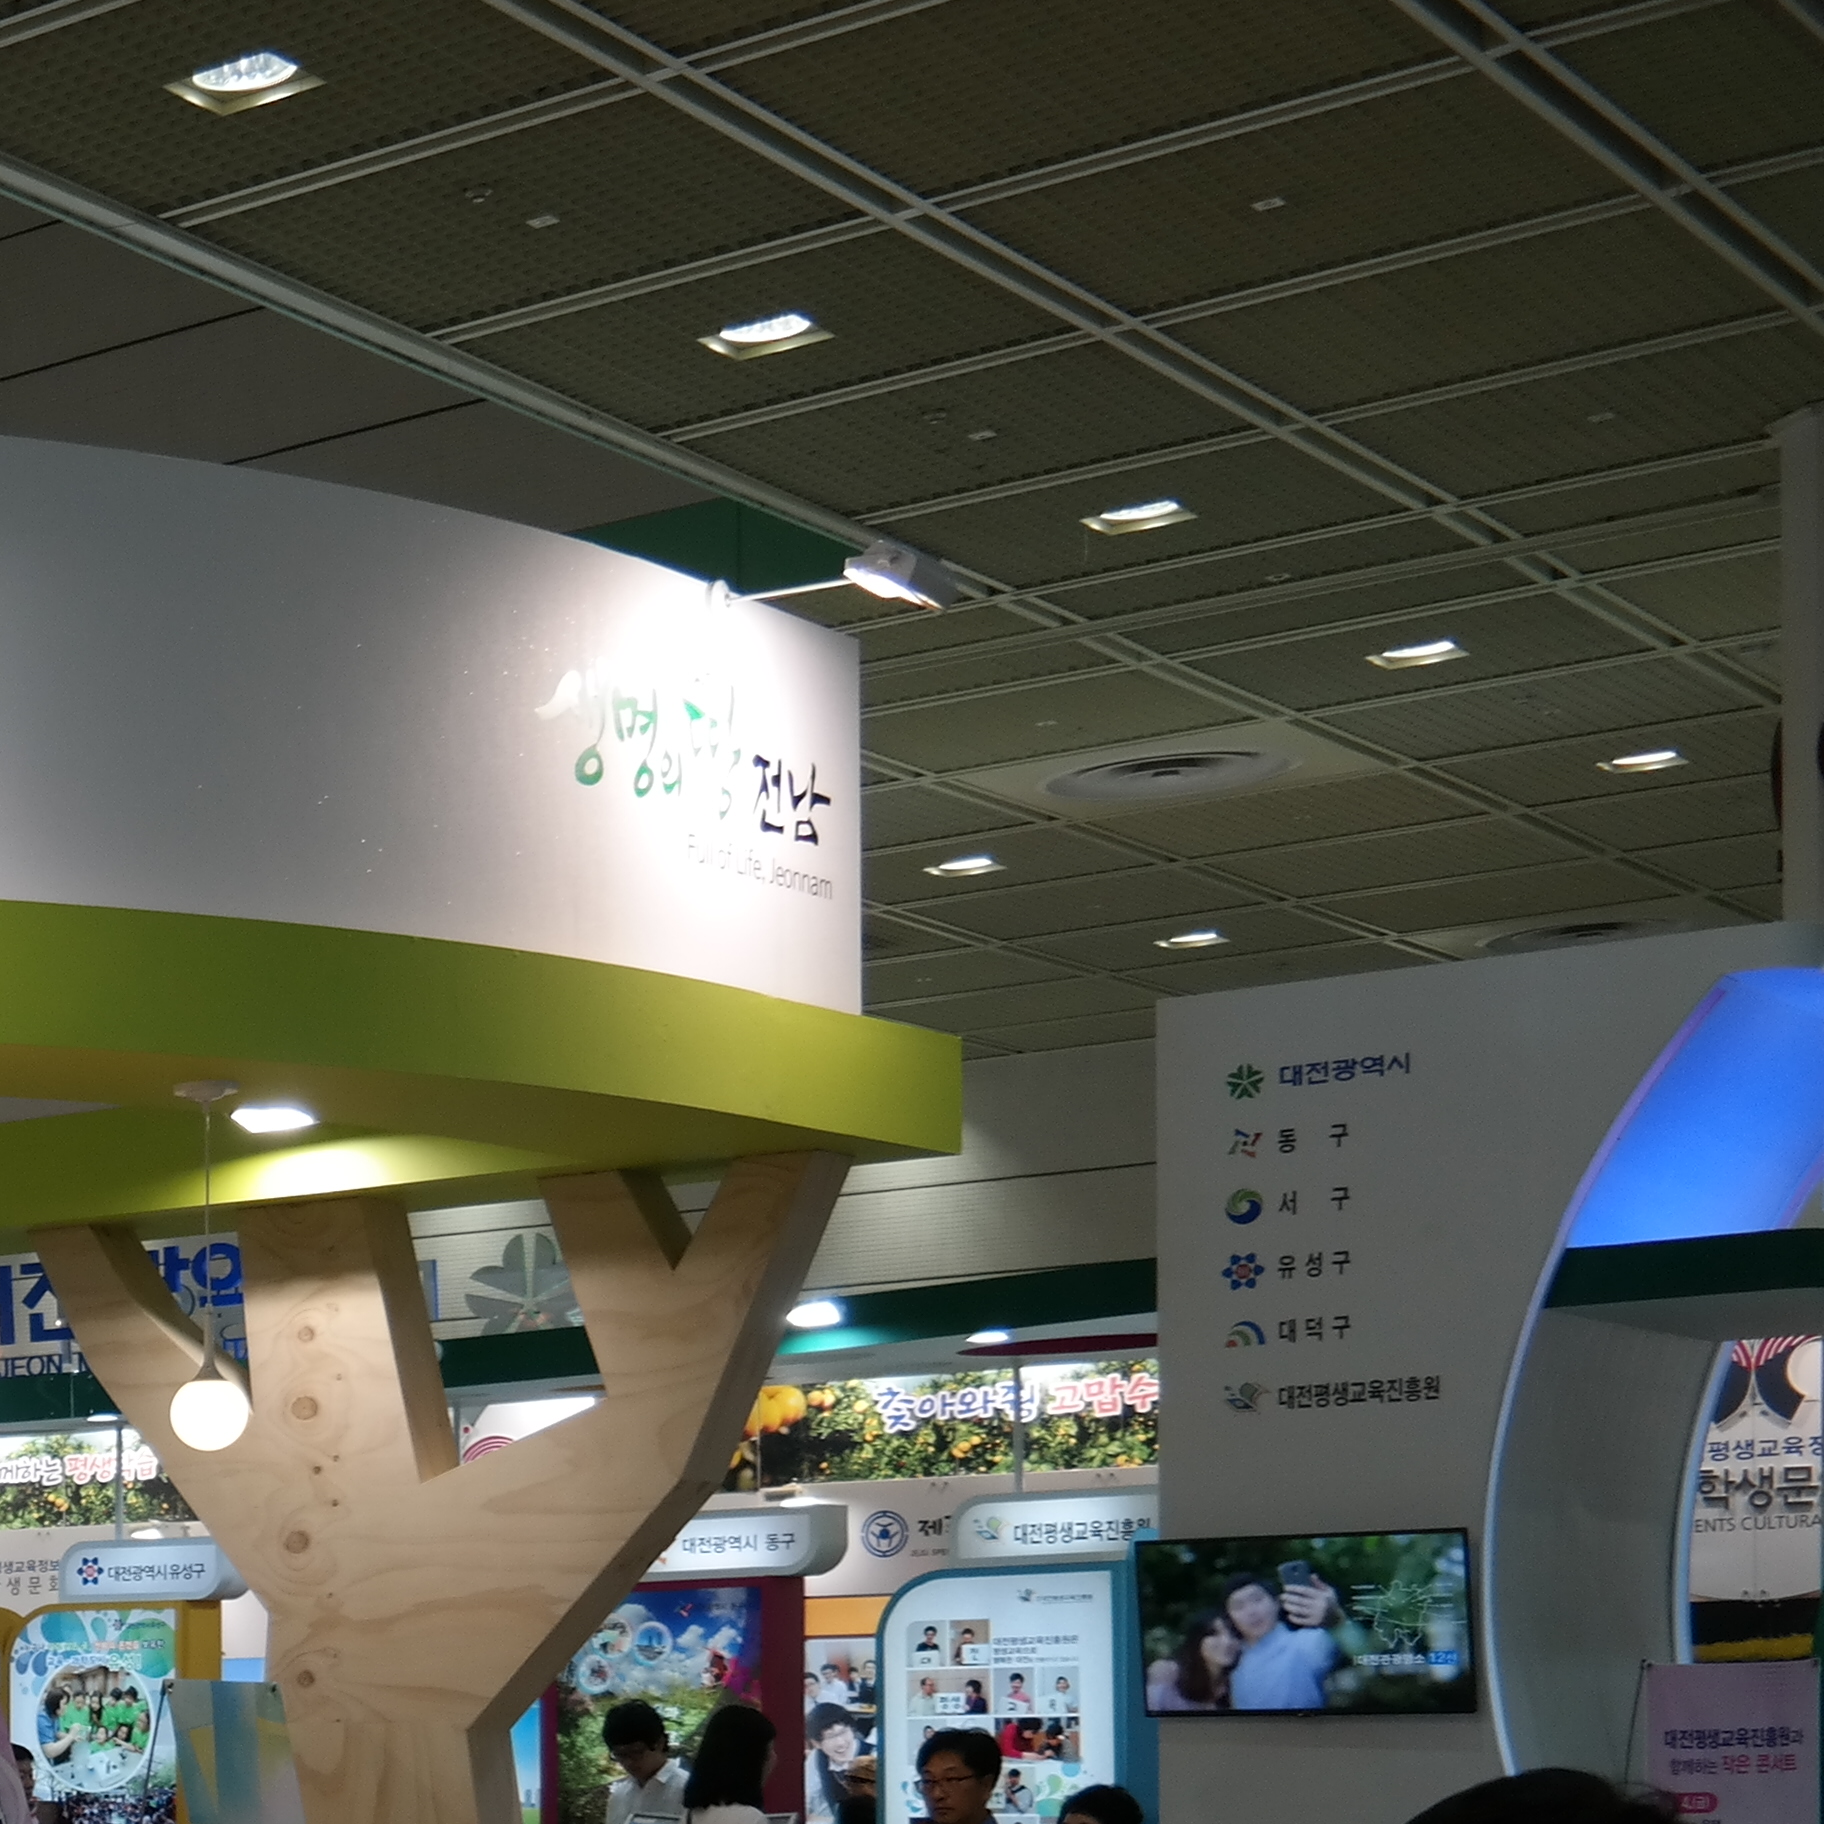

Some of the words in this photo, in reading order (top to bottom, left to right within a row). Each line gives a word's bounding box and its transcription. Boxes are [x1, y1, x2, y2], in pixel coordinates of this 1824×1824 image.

[752, 753, 831, 845] 전남
[687, 833, 713, 864] Full
[717, 844, 733, 870] of
[769, 859, 833, 900] Jeonnam
[1278, 1051, 1412, 1088] 대전광역시
[1278, 1375, 1441, 1409] 대전평생교육진흥원
[682, 1532, 759, 1554] 대전광역시
[765, 1531, 796, 1552] 동구
[107, 1565, 168, 1582] 대전광역시
[169, 1562, 206, 1581] 유성구
